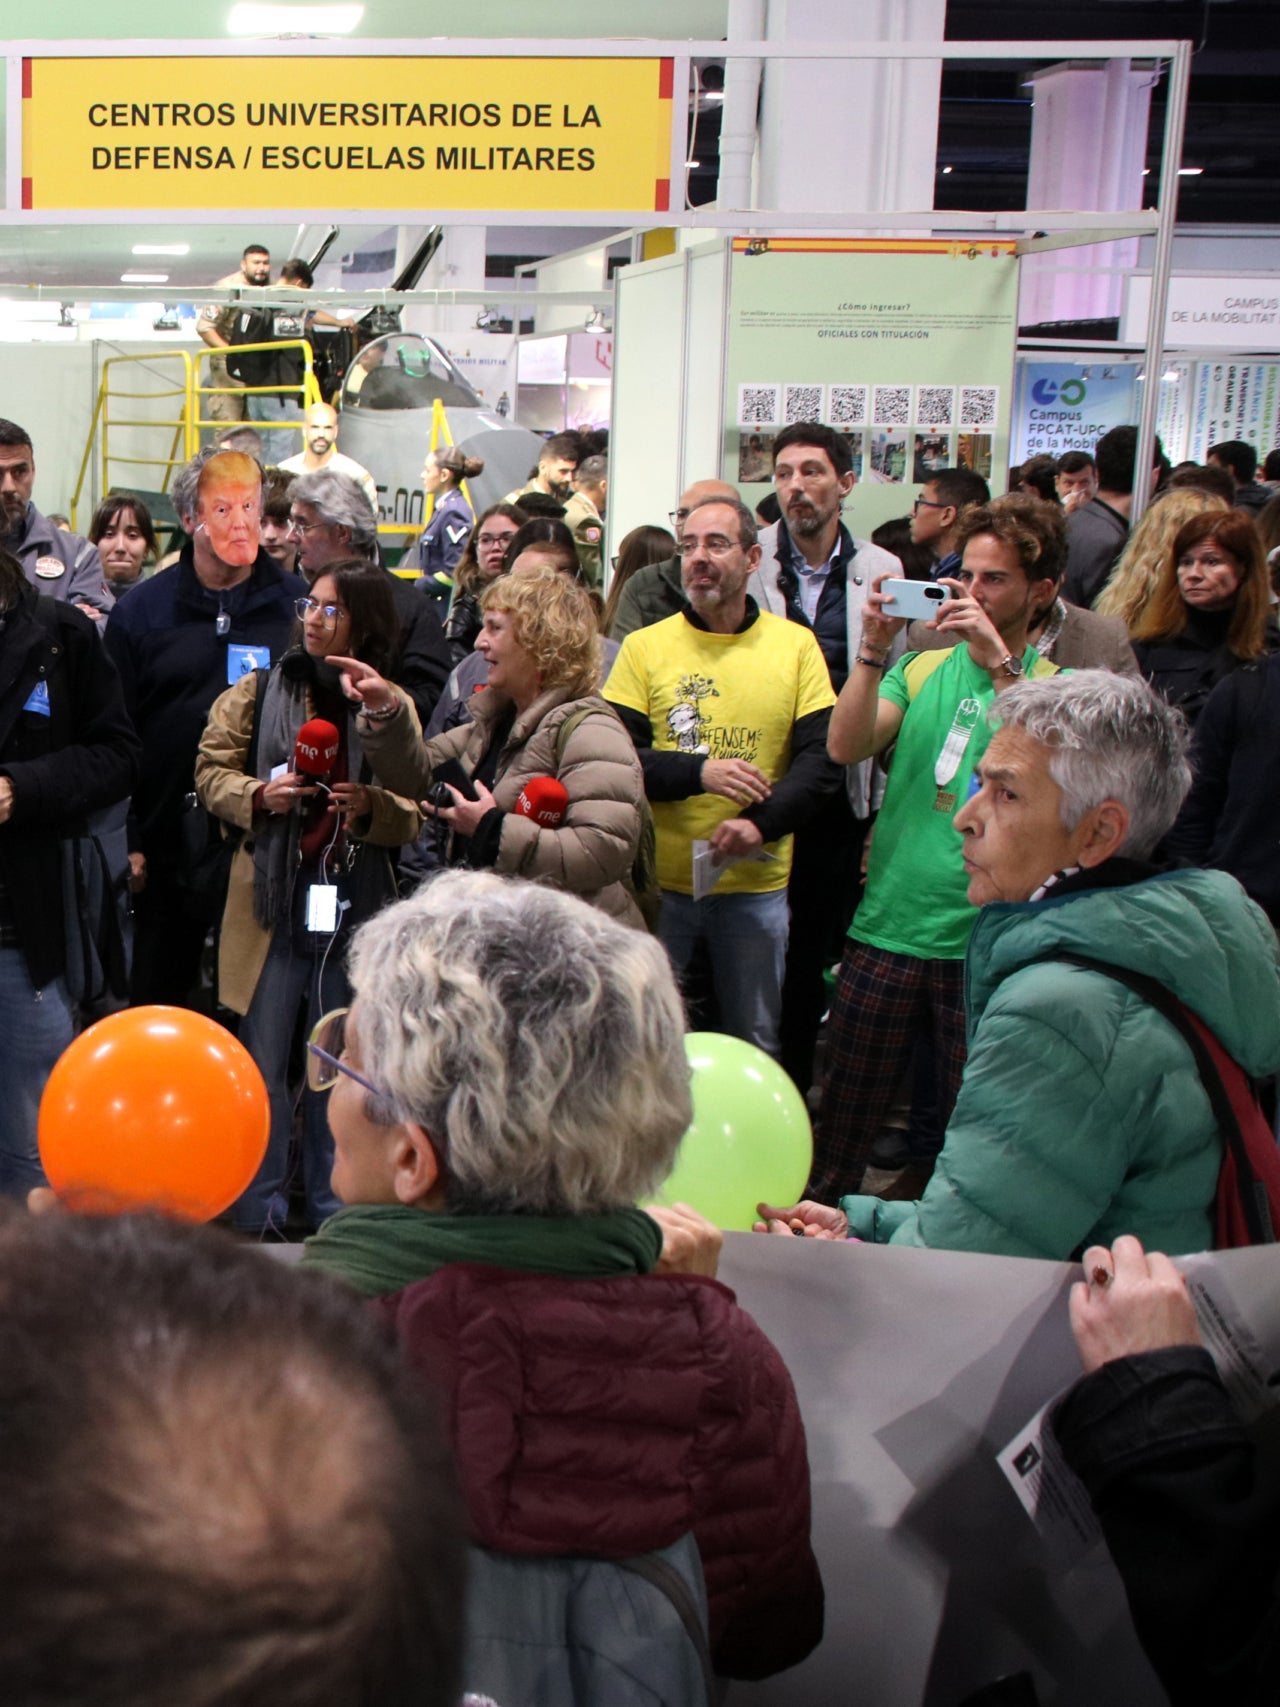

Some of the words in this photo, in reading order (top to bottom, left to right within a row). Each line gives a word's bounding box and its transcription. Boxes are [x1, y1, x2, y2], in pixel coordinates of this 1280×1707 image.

[88, 102, 236, 128] CENTROS
[246, 102, 502, 128] UNIVERSITARIOS
[512, 103, 553, 128] DE
[563, 104, 603, 129] LA
[92, 146, 236, 171] DEFENSA
[243, 146, 252, 170] /
[262, 145, 426, 171] ESCUELAS
[436, 146, 596, 172] MILITARES
[870, 303, 911, 312] ingresar?
[1223, 297, 1279, 311] CAMPUS
[1171, 311, 1189, 323] DE
[1192, 311, 1208, 323] LA
[1211, 311, 1276, 324] MOBILITAT
[817, 329, 859, 338] OFICIALES
[861, 330, 879, 338] CON
[881, 329, 929, 339] TITULACIÓN
[1225, 365, 1237, 393] GRAU
[1237, 366, 1250, 424] TRANSPORT
[1029, 408, 1082, 421] Campus
[1028, 423, 1106, 436] FPCAT-UPC
[1207, 420, 1217, 446] XARX
[1027, 437, 1044, 448] de
[1047, 436, 1059, 448] la
[1062, 437, 1097, 449] Mobil
[518, 791, 532, 814] rne
[537, 810, 561, 823] rne
